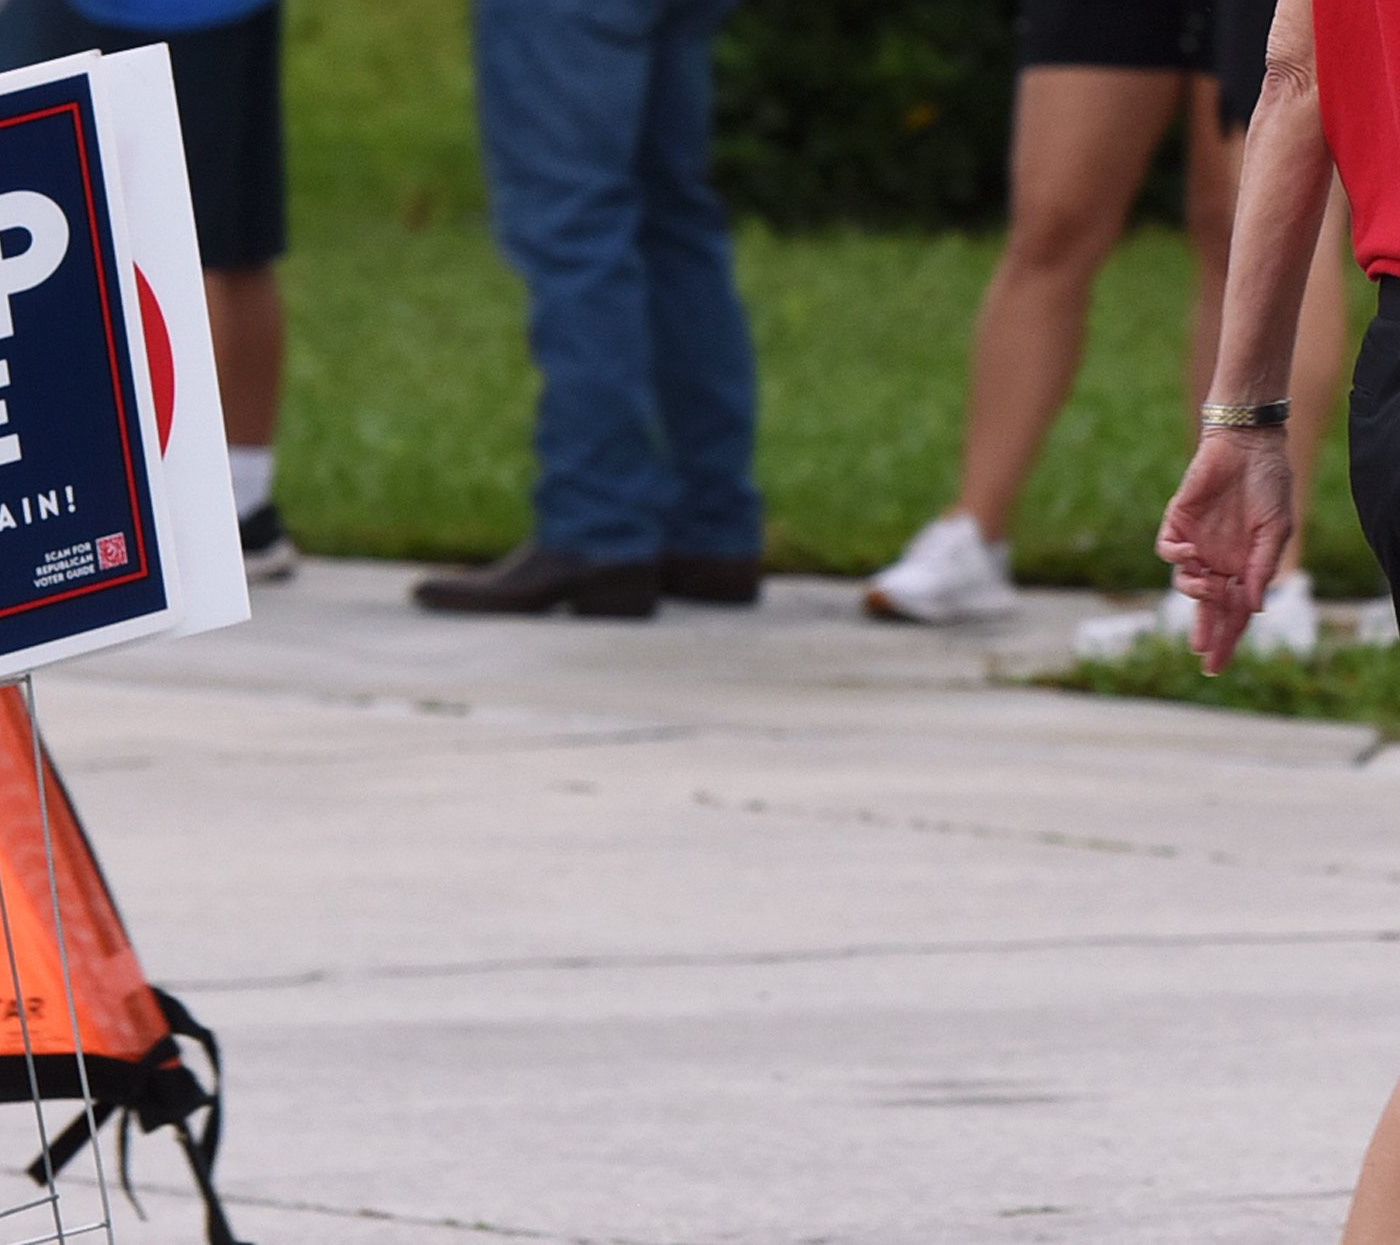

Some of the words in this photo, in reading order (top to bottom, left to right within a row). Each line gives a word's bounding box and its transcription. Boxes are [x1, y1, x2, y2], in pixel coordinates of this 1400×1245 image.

[44, 547, 71, 563] SCAN
[72, 542, 92, 555] FOR
[33, 573, 65, 588] VOTER
[66, 563, 95, 580] GUIDE
[35, 554, 94, 576] REPUBLICAN
